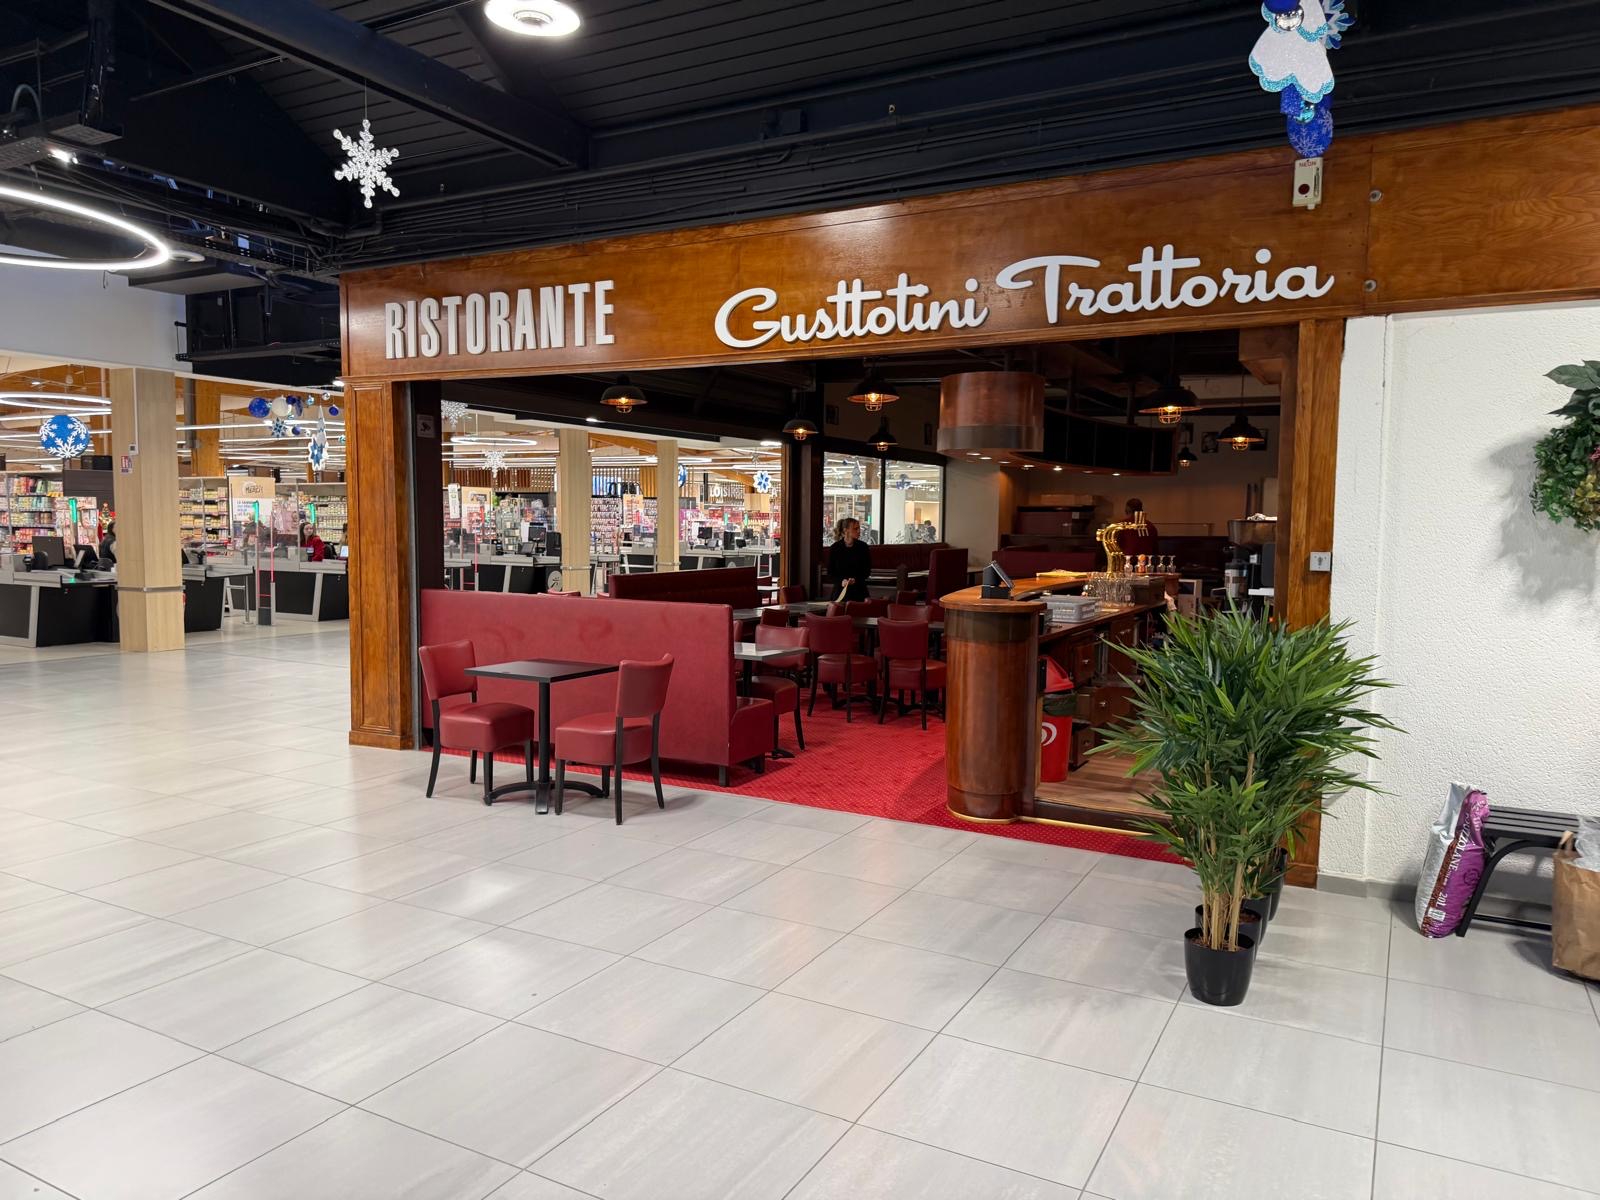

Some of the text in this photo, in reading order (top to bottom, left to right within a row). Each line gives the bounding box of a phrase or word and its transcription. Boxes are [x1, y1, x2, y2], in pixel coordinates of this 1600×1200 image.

[385, 280, 615, 360] RISTORANTE
[995, 244, 1335, 325] Trattoria
[1436, 892, 1448, 908] 20L
